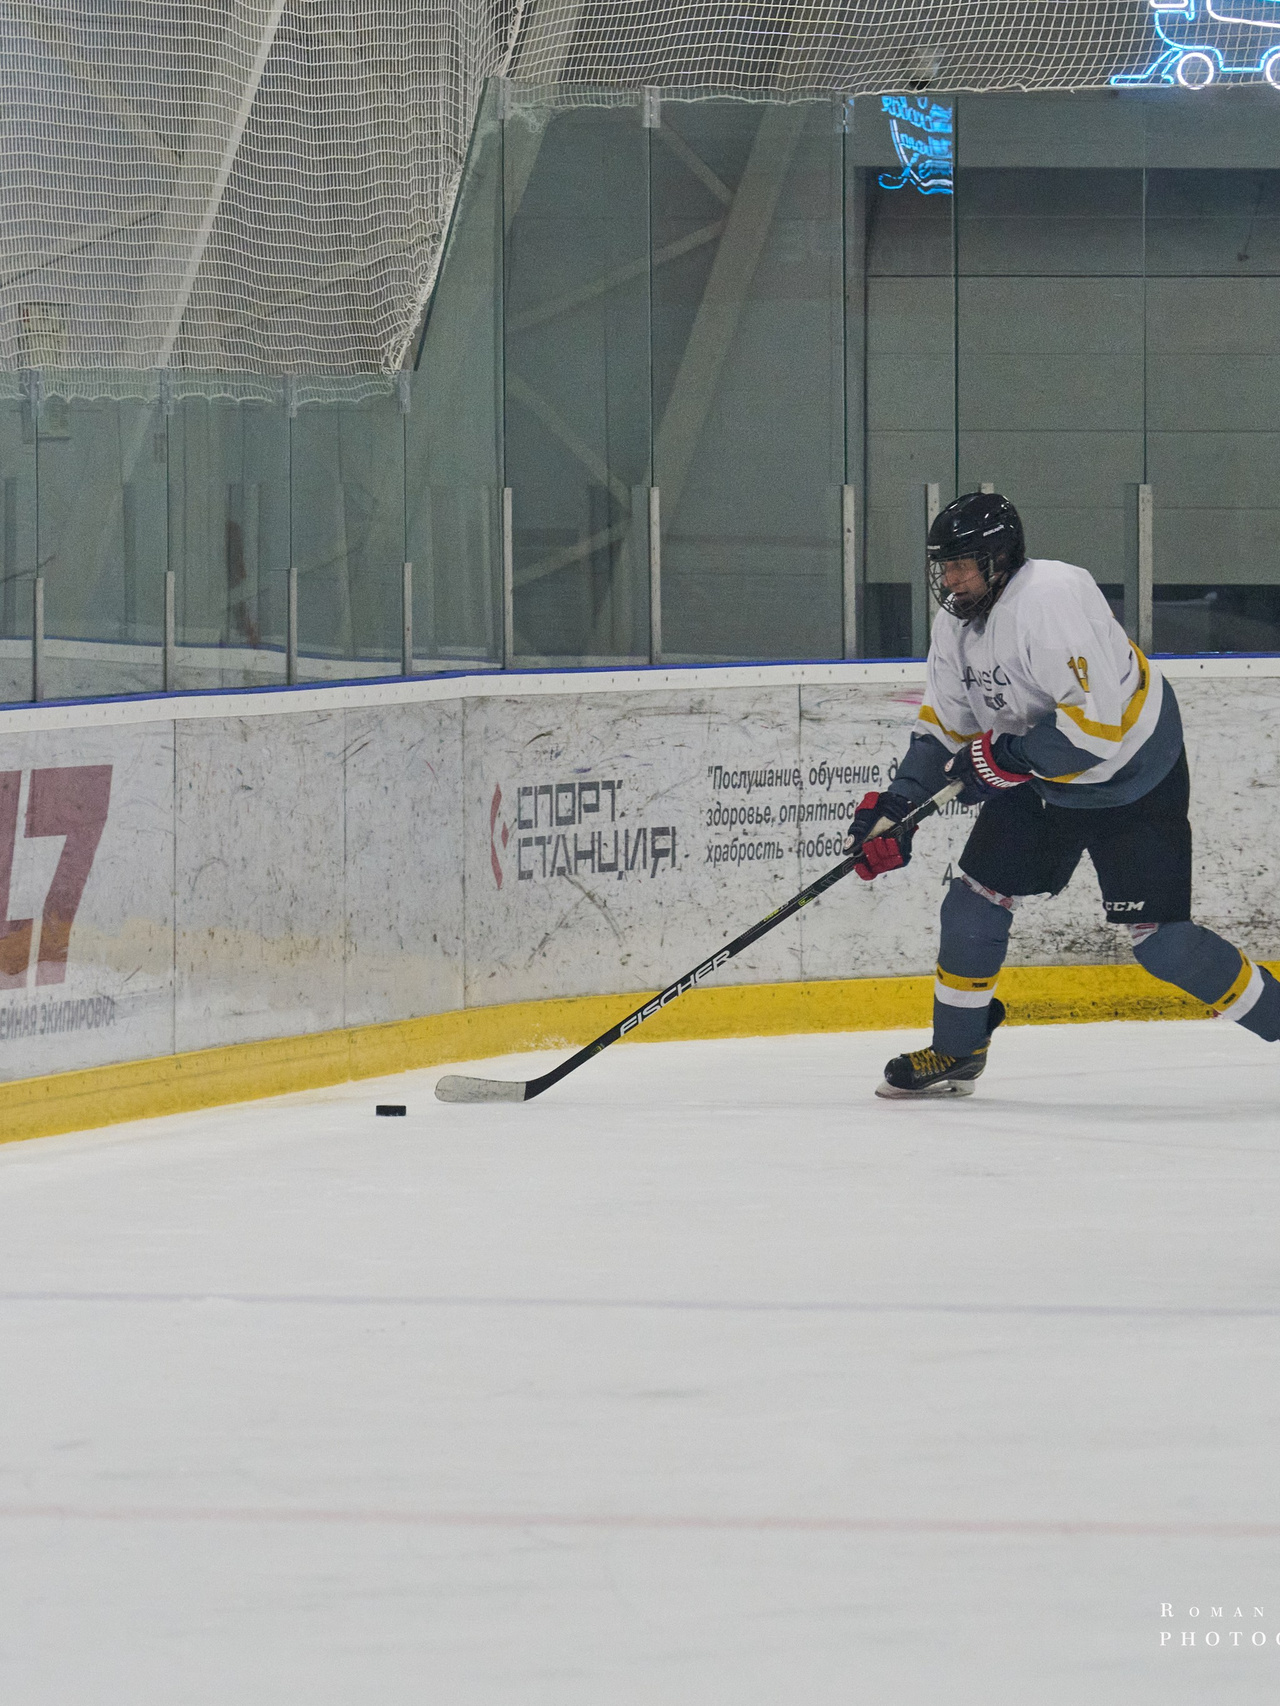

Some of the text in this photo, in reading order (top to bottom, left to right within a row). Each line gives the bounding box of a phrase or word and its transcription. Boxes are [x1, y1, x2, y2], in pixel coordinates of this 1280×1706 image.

[809, 760, 883, 792] обучение,
[517, 779, 624, 830] СПОРТ
[706, 801, 857, 832] здоровье, опрятнос
[517, 825, 676, 880] СТАНЦИЯ
[705, 837, 784, 868] храбрость
[797, 831, 847, 859] побед
[1105, 901, 1146, 912] CCM
[620, 950, 730, 1037] FISCHER
